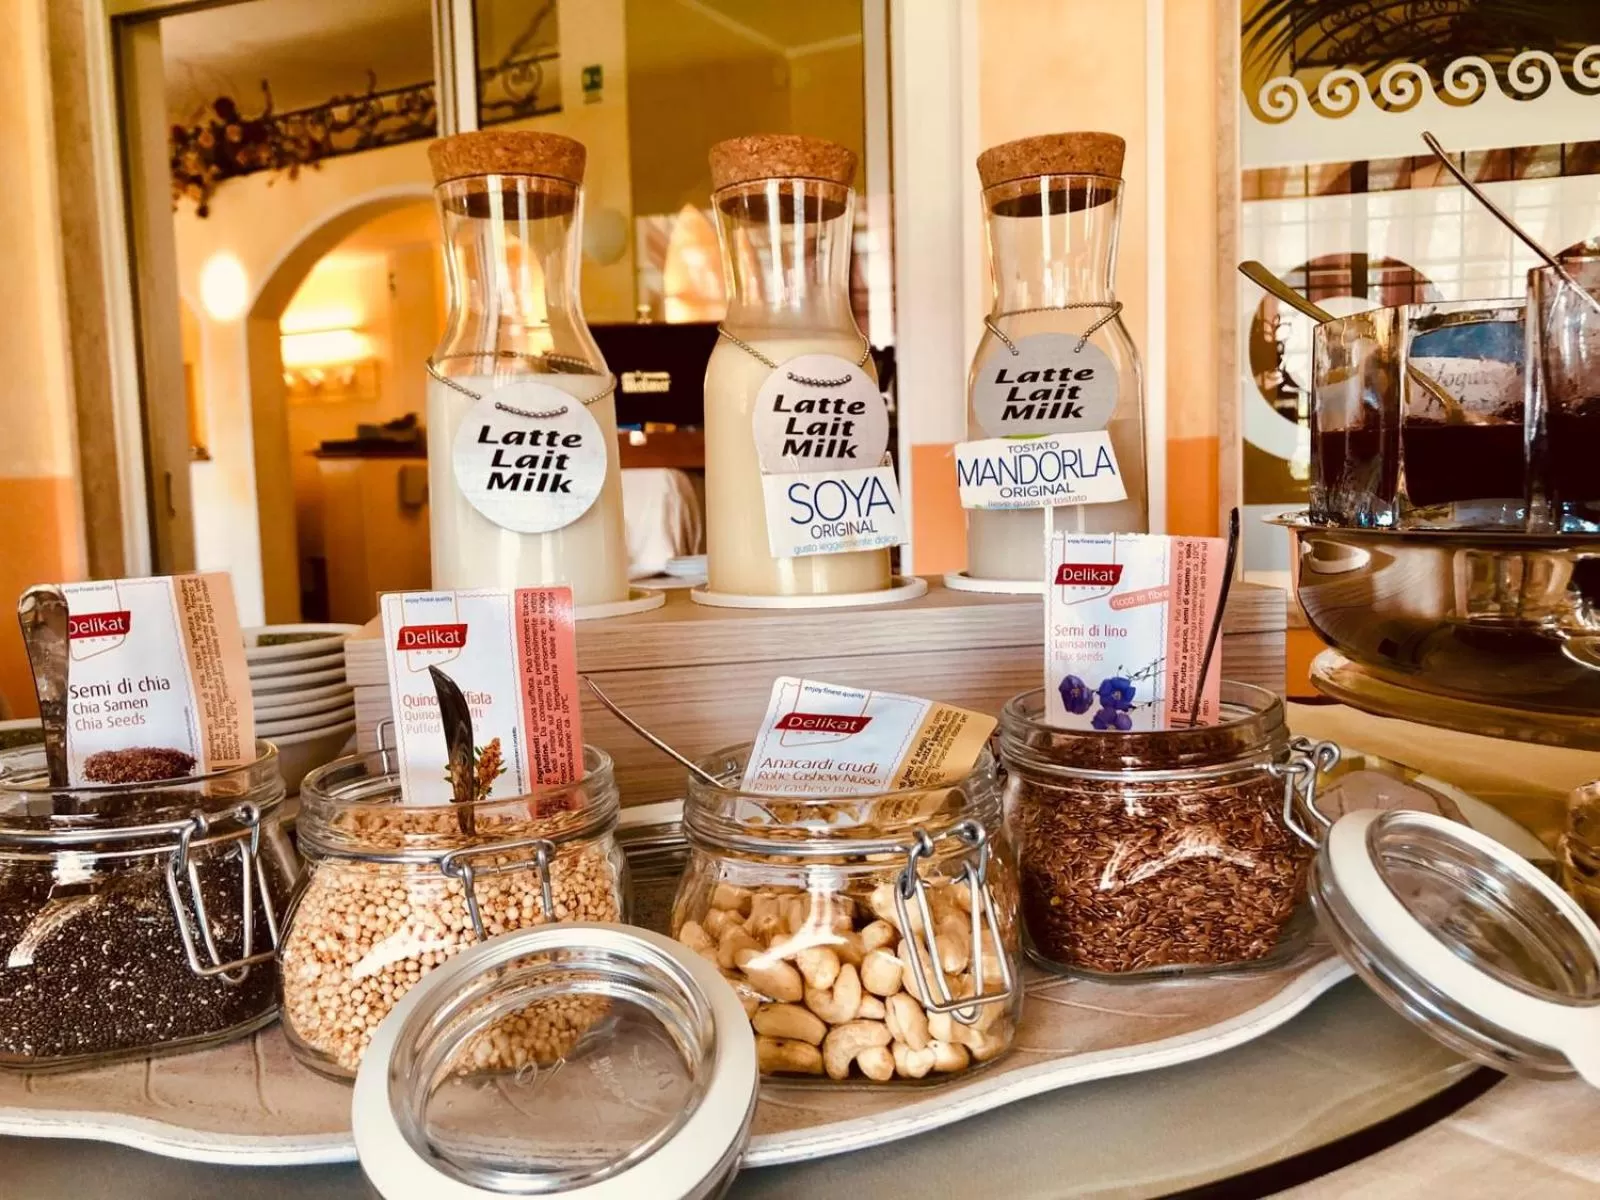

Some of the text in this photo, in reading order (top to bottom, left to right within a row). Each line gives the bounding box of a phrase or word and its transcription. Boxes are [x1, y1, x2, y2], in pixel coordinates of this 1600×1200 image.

[995, 368, 1094, 384] Latte
[1006, 383, 1082, 402] Lait
[773, 394, 866, 415] Latte
[1001, 402, 1084, 420] Milk
[785, 417, 855, 436] Lait
[478, 425, 582, 448] Latte
[782, 438, 858, 459] Milk
[1007, 441, 1060, 454] TOSTATO
[491, 449, 570, 470] Lait
[957, 445, 1116, 488] MANDORLA
[486, 472, 573, 493] Milk
[1000, 482, 1075, 498] ORIGINAL
[788, 476, 896, 525] SOYA
[1013, 499, 1040, 508] gusto
[1042, 498, 1053, 506] di
[1055, 494, 1088, 505] tostato
[810, 520, 878, 540] ORIGINAL
[1062, 568, 1114, 582] Delikat
[530, 592, 538, 614] entro
[404, 628, 461, 646] Delikat
[523, 618, 532, 657] contenere
[1054, 624, 1127, 637] Semi di lino
[531, 618, 542, 676] preferibilmente
[1055, 639, 1106, 649] Leinsamen
[525, 658, 533, 673] Può
[69, 675, 171, 699] Semi di chia
[805, 686, 822, 694] enjoy
[823, 687, 841, 696] finest
[72, 698, 149, 715] Chia Samen
[403, 693, 440, 710] Quino
[537, 679, 546, 722] consumarsi
[75, 712, 147, 731] Chia Seeds
[530, 707, 539, 733] quinoa
[787, 716, 858, 731] Delikat
[539, 726, 547, 737] Da
[532, 735, 544, 785] Ingredienti:
[542, 741, 551, 774] glutine.
[760, 757, 879, 774] Anacardi crudi
[758, 770, 789, 781] Rohe
[793, 771, 838, 781] Cashew
